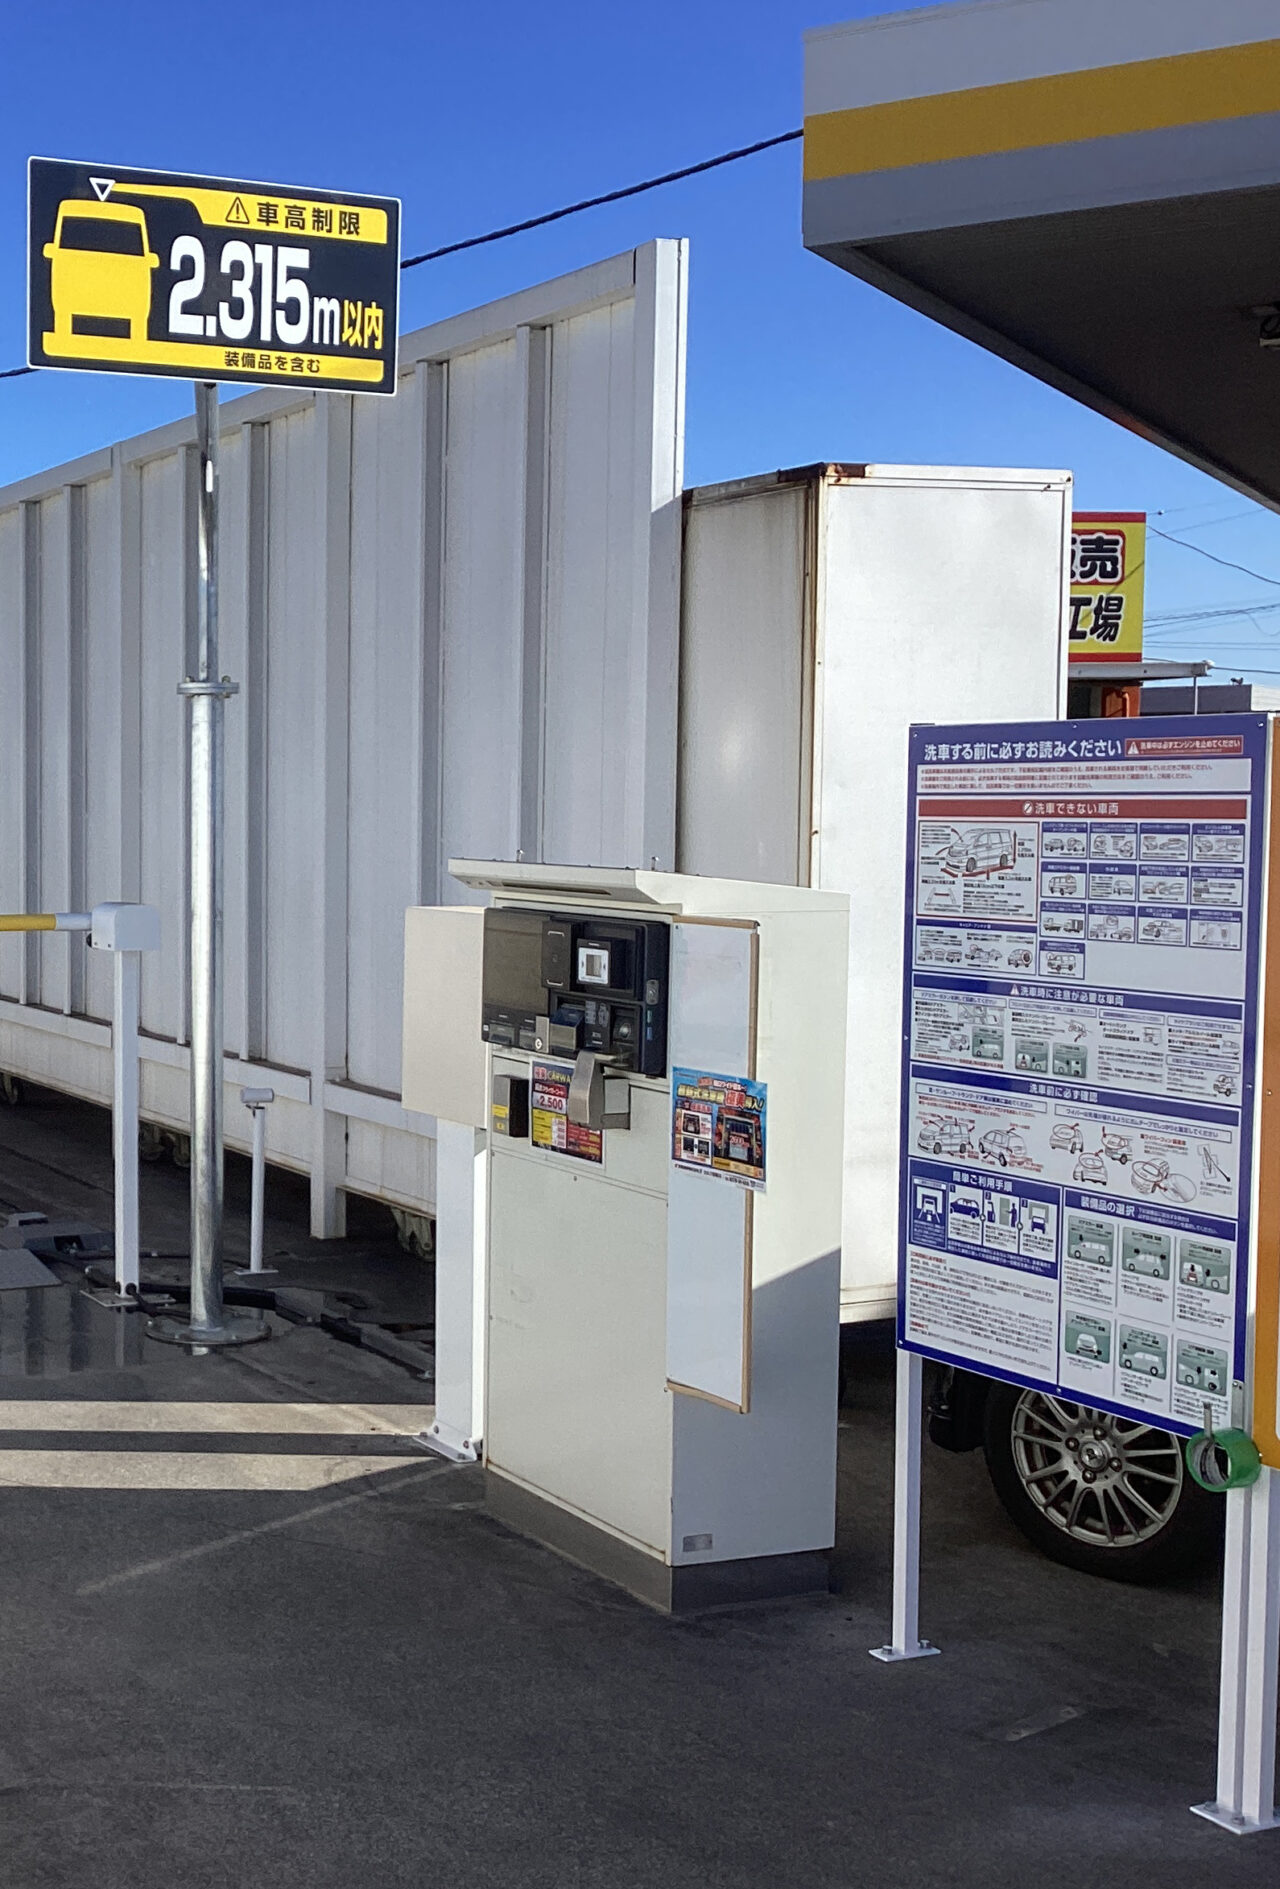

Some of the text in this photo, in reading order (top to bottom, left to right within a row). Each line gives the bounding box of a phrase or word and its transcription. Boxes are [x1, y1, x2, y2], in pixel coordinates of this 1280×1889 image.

[257, 202, 361, 236] 車高制限
[224, 351, 321, 374] 装備品を含む
[1071, 535, 1121, 579] 売
[924, 739, 1122, 761] 洗車する前に必ずお読みください
[1035, 802, 1119, 815] 洗車できない車両
[1020, 985, 1124, 1006] 洗車時に注意が必要な車両
[1029, 1084, 1098, 1103] 洗車前に必ず確認
[952, 1171, 1013, 1192] 簡単ご利用手順
[1080, 1196, 1136, 1217] 装備品の選択
